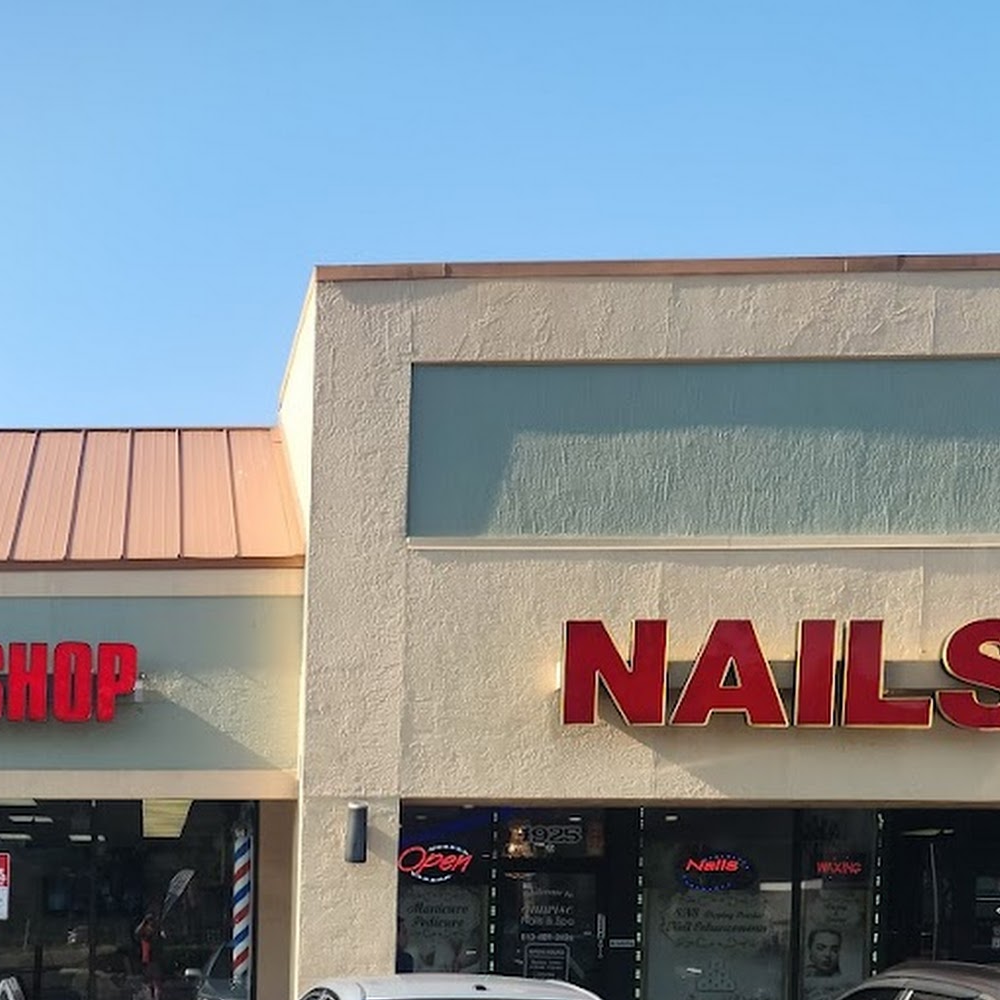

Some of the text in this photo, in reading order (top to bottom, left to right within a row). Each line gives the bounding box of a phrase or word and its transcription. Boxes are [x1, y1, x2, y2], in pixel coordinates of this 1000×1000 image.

[562, 617, 1000, 732] NAILS
[396, 846, 473, 873] Open
[685, 859, 740, 872] Nails
